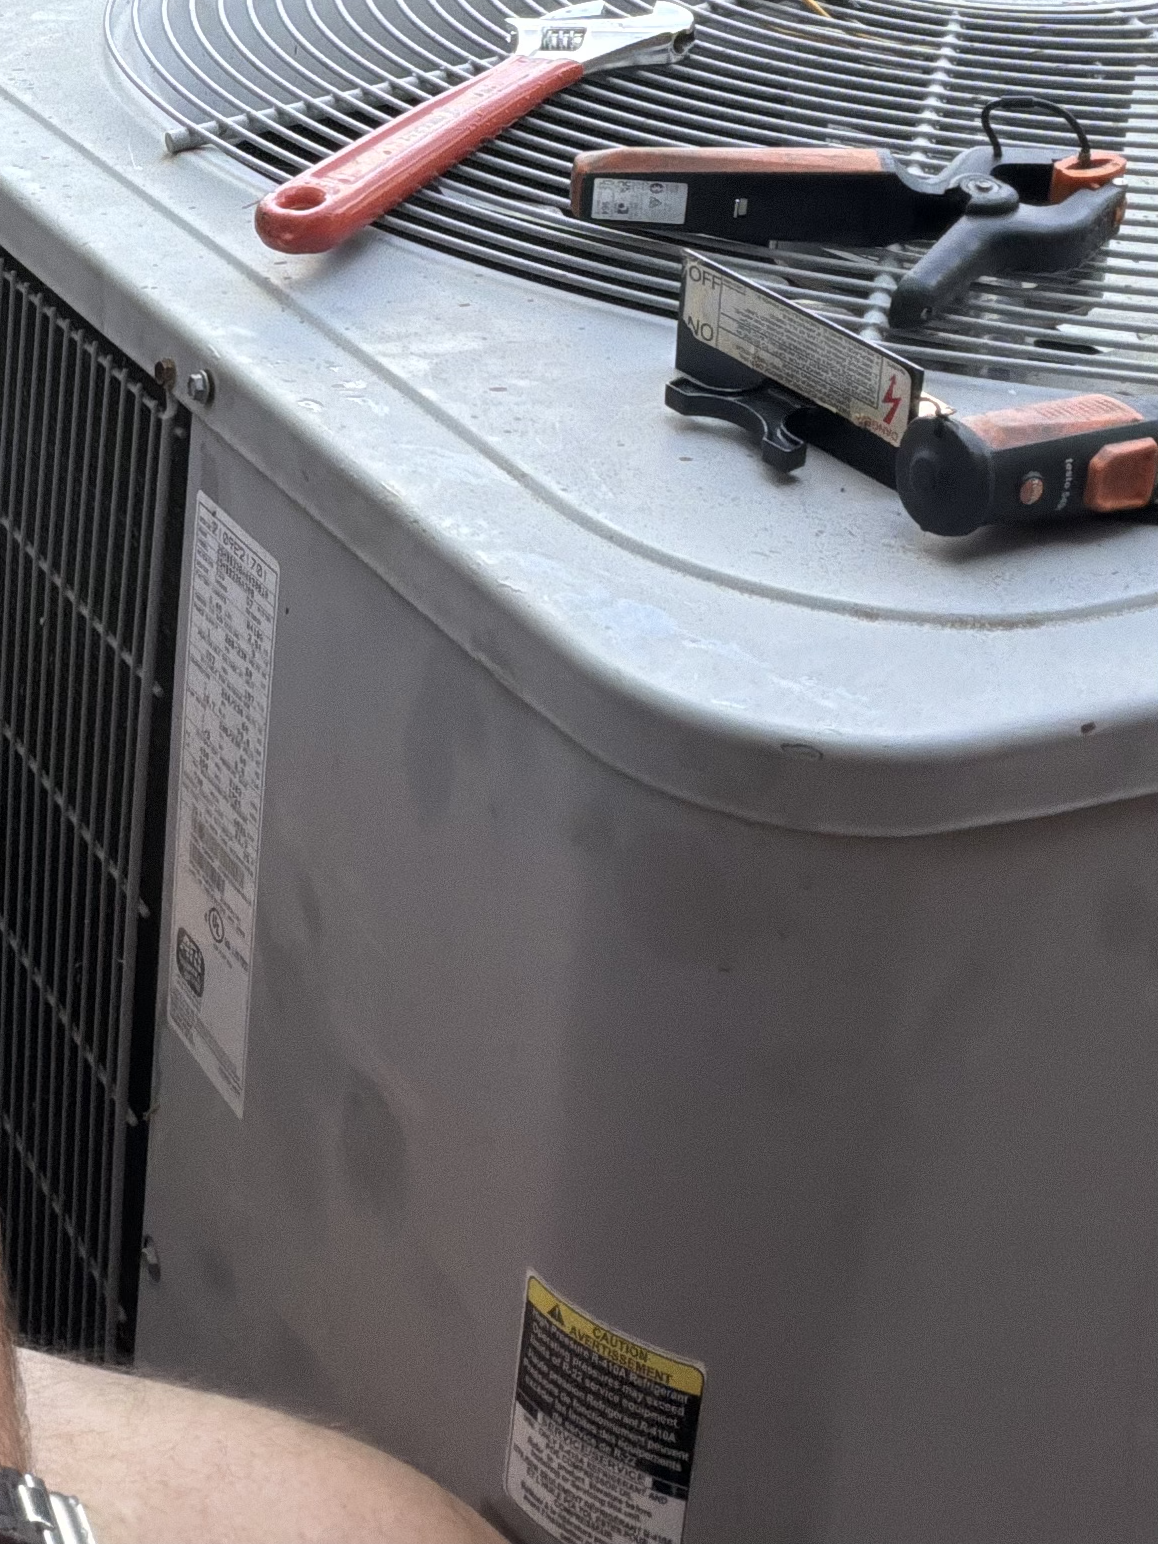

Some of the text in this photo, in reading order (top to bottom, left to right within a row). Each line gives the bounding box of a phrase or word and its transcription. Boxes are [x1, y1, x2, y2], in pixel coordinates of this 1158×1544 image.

[689, 265, 722, 290] OFF
[569, 1326, 674, 1384] AVERTISSEMENT
[592, 1327, 648, 1362] CAUTION
[585, 1377, 619, 1403] service
[592, 1352, 626, 1378] R-410A
[630, 1371, 688, 1405] Refrigerant
[622, 1384, 644, 1404] may
[646, 1396, 685, 1416] exceed
[640, 1419, 676, 1443] R-410A
